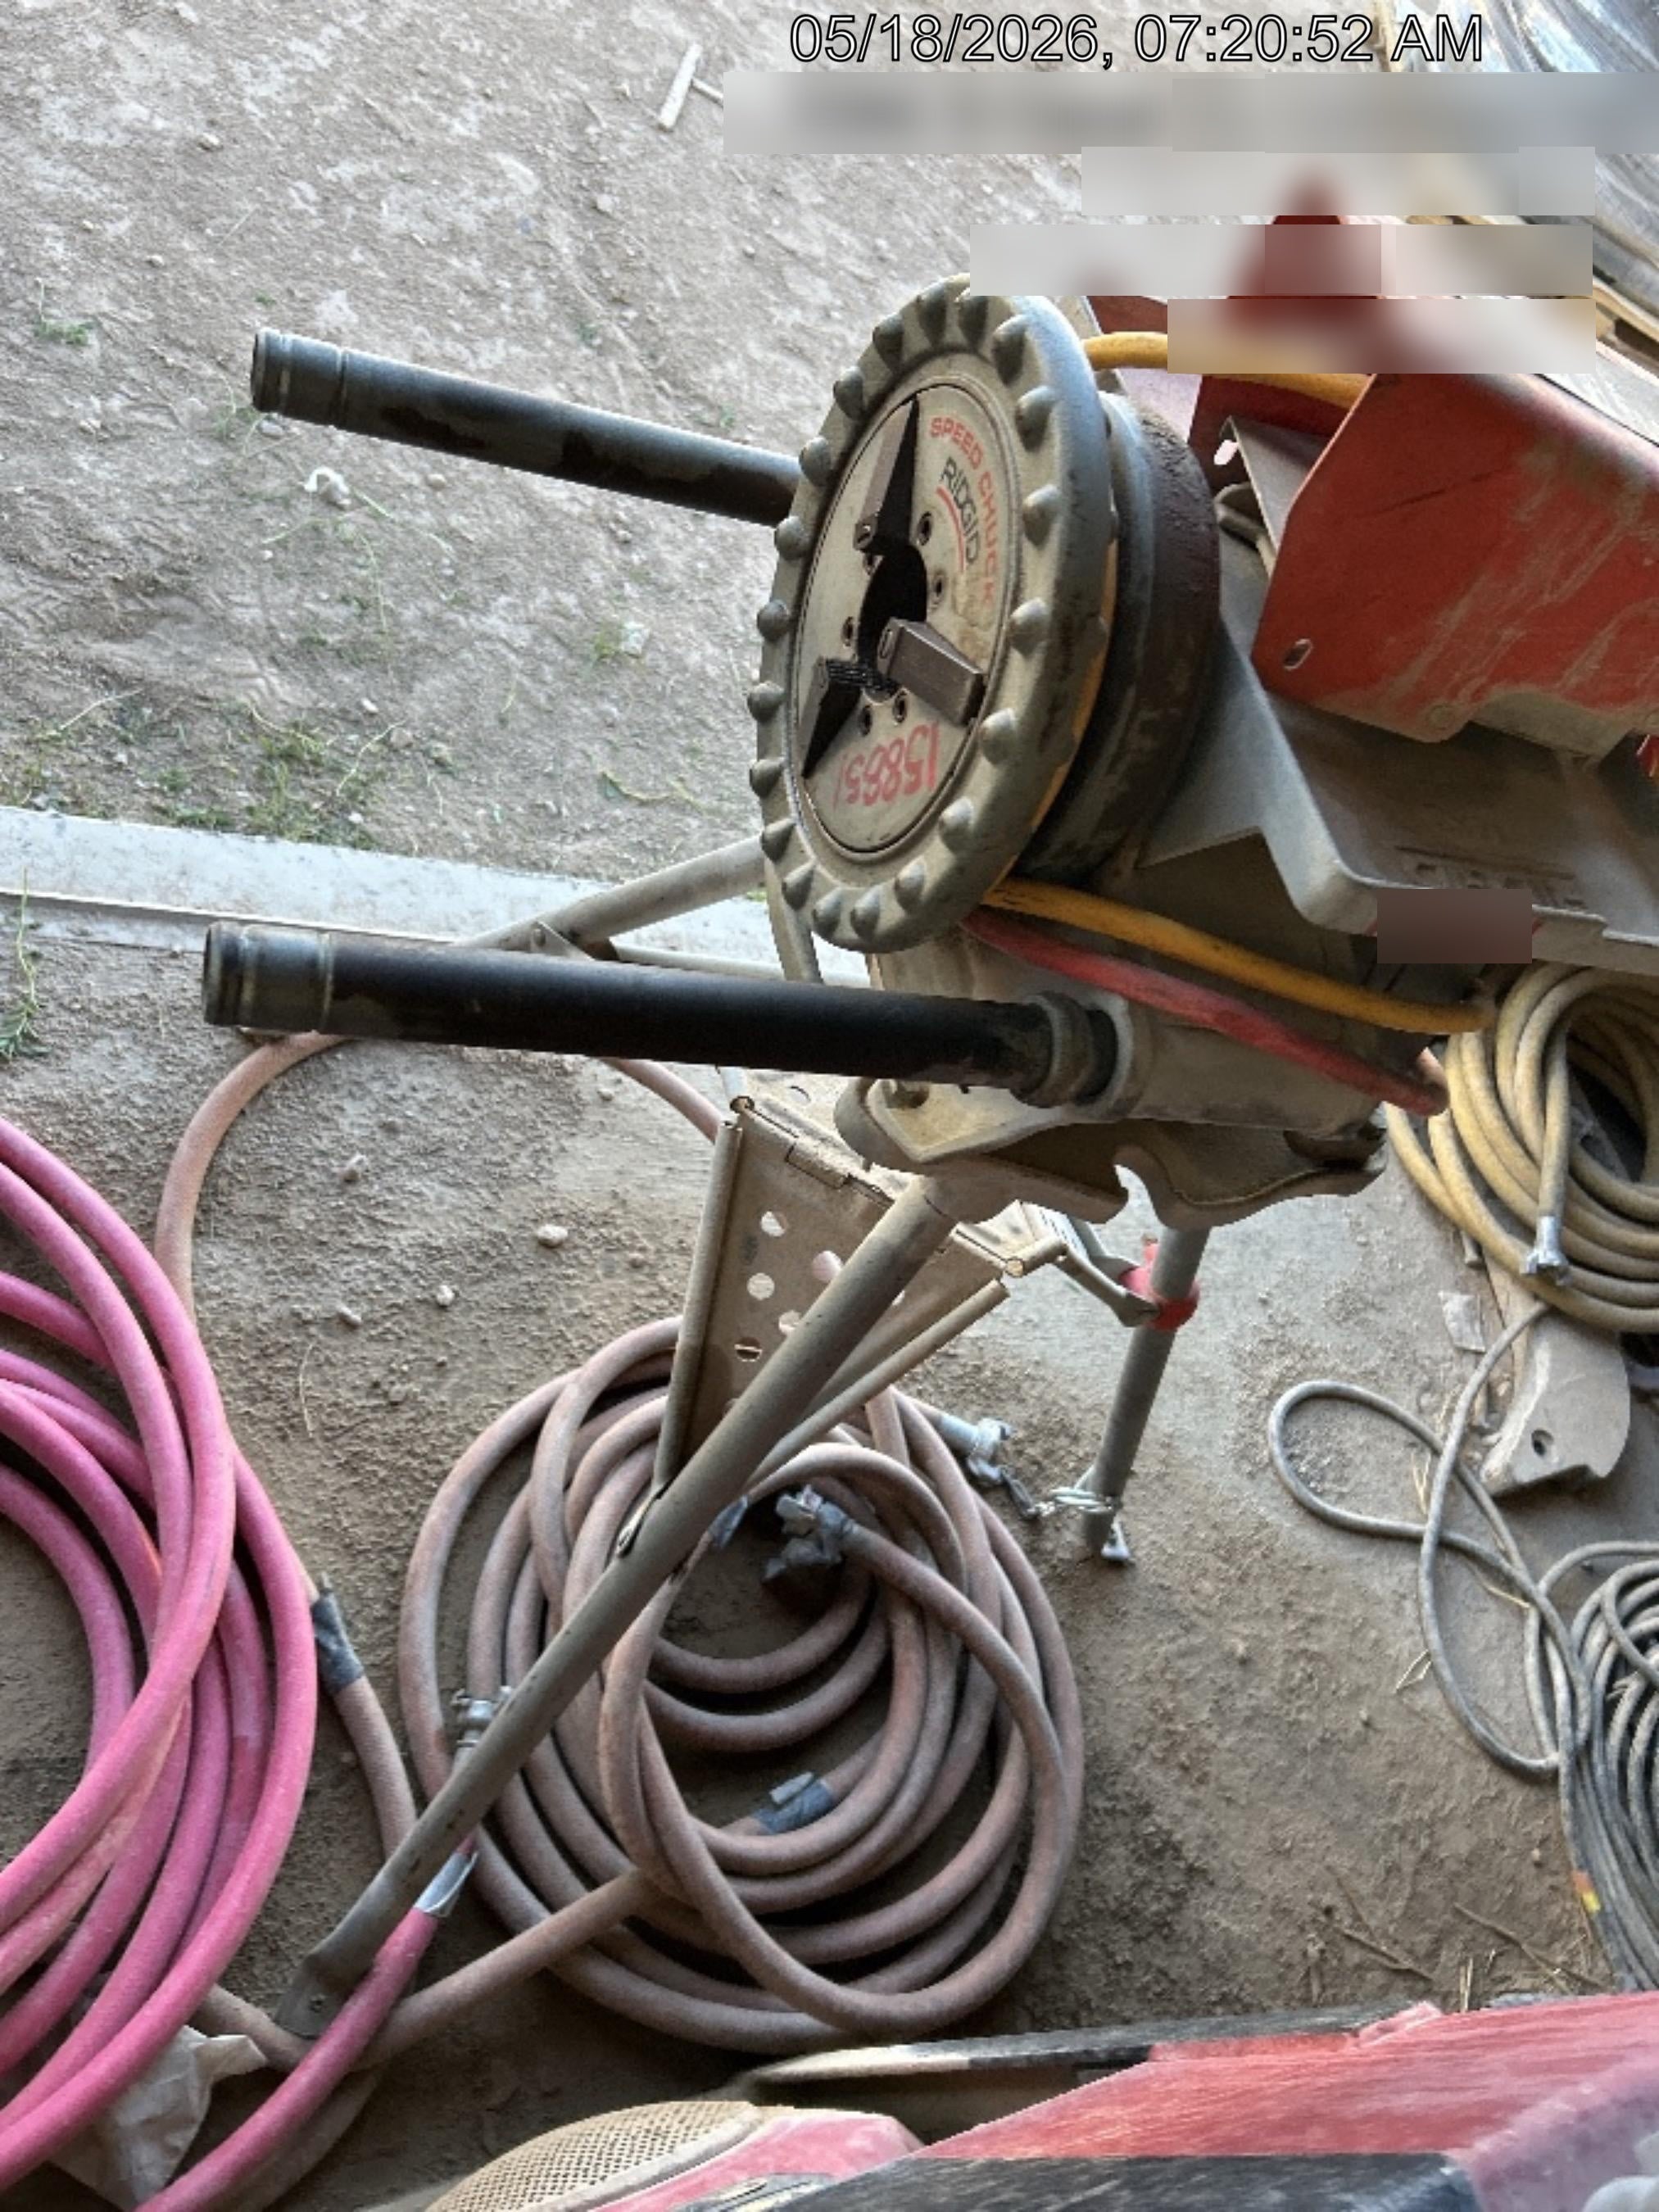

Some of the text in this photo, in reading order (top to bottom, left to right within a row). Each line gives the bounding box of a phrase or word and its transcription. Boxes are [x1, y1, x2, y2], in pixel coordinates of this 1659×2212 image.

[930, 416, 998, 608] SPEED CHUCK
[940, 456, 981, 564] RIDGID
